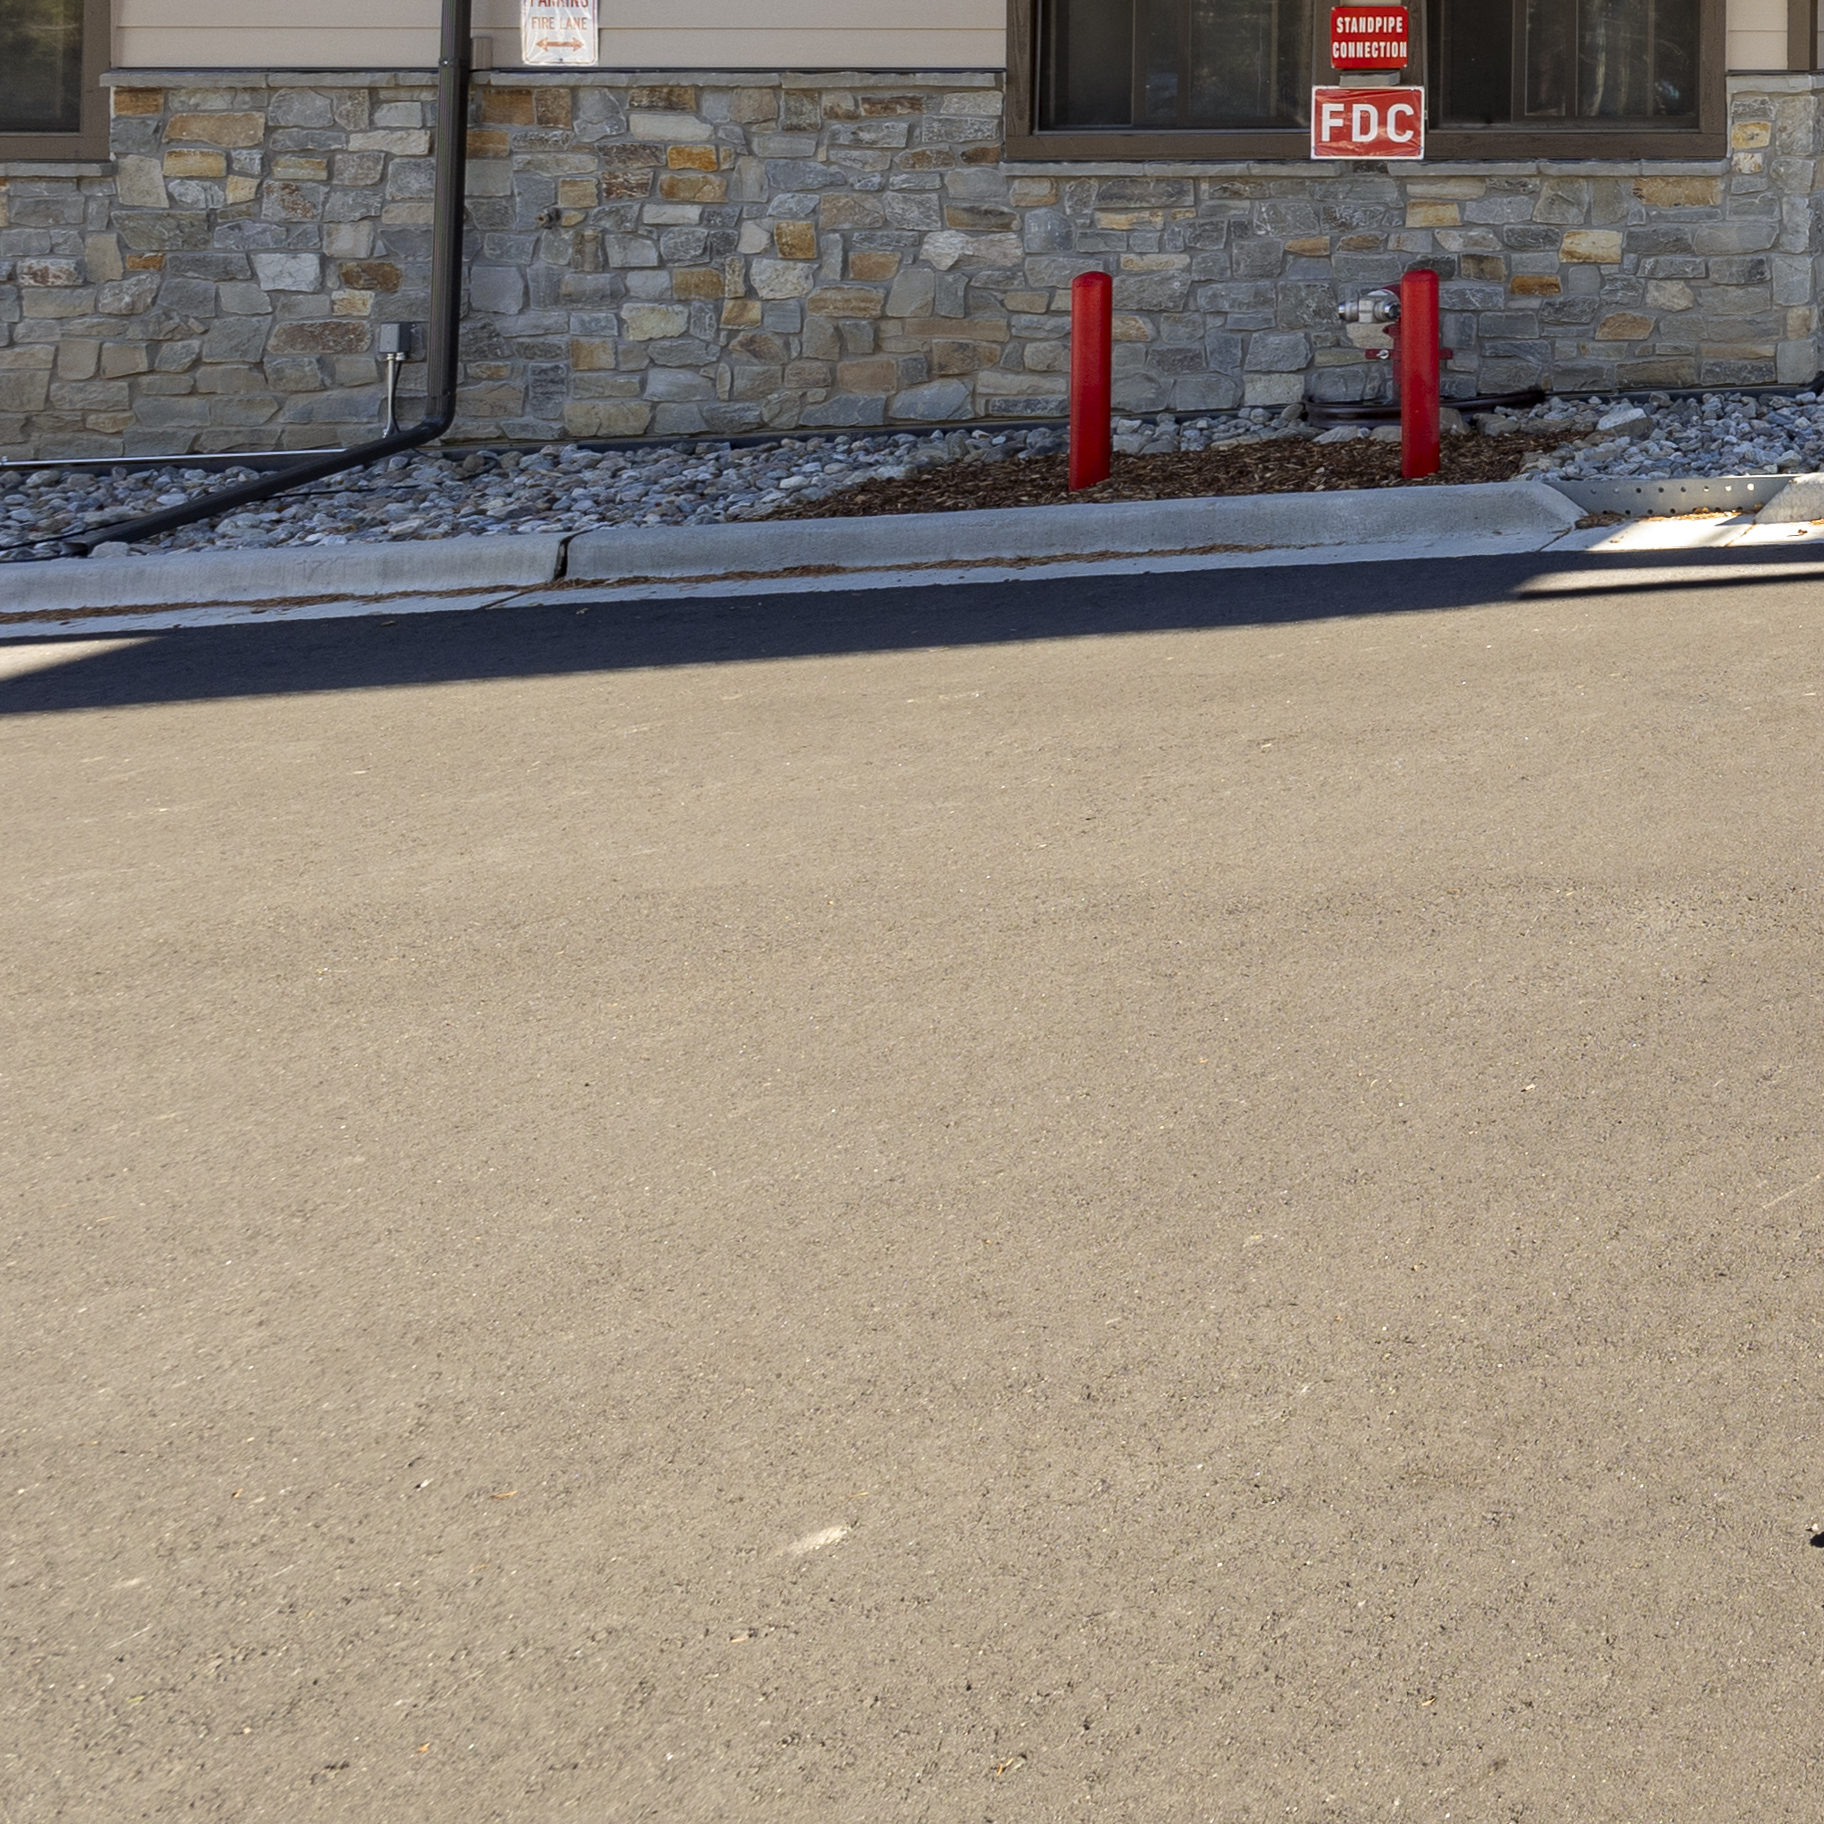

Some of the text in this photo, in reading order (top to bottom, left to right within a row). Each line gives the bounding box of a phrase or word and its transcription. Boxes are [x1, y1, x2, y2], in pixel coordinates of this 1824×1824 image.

[531, 16, 588, 30] FIRE LANE
[1336, 16, 1403, 34] STANDPIPE
[1332, 41, 1407, 59] CONNECTION
[1321, 103, 1415, 143] FDC
